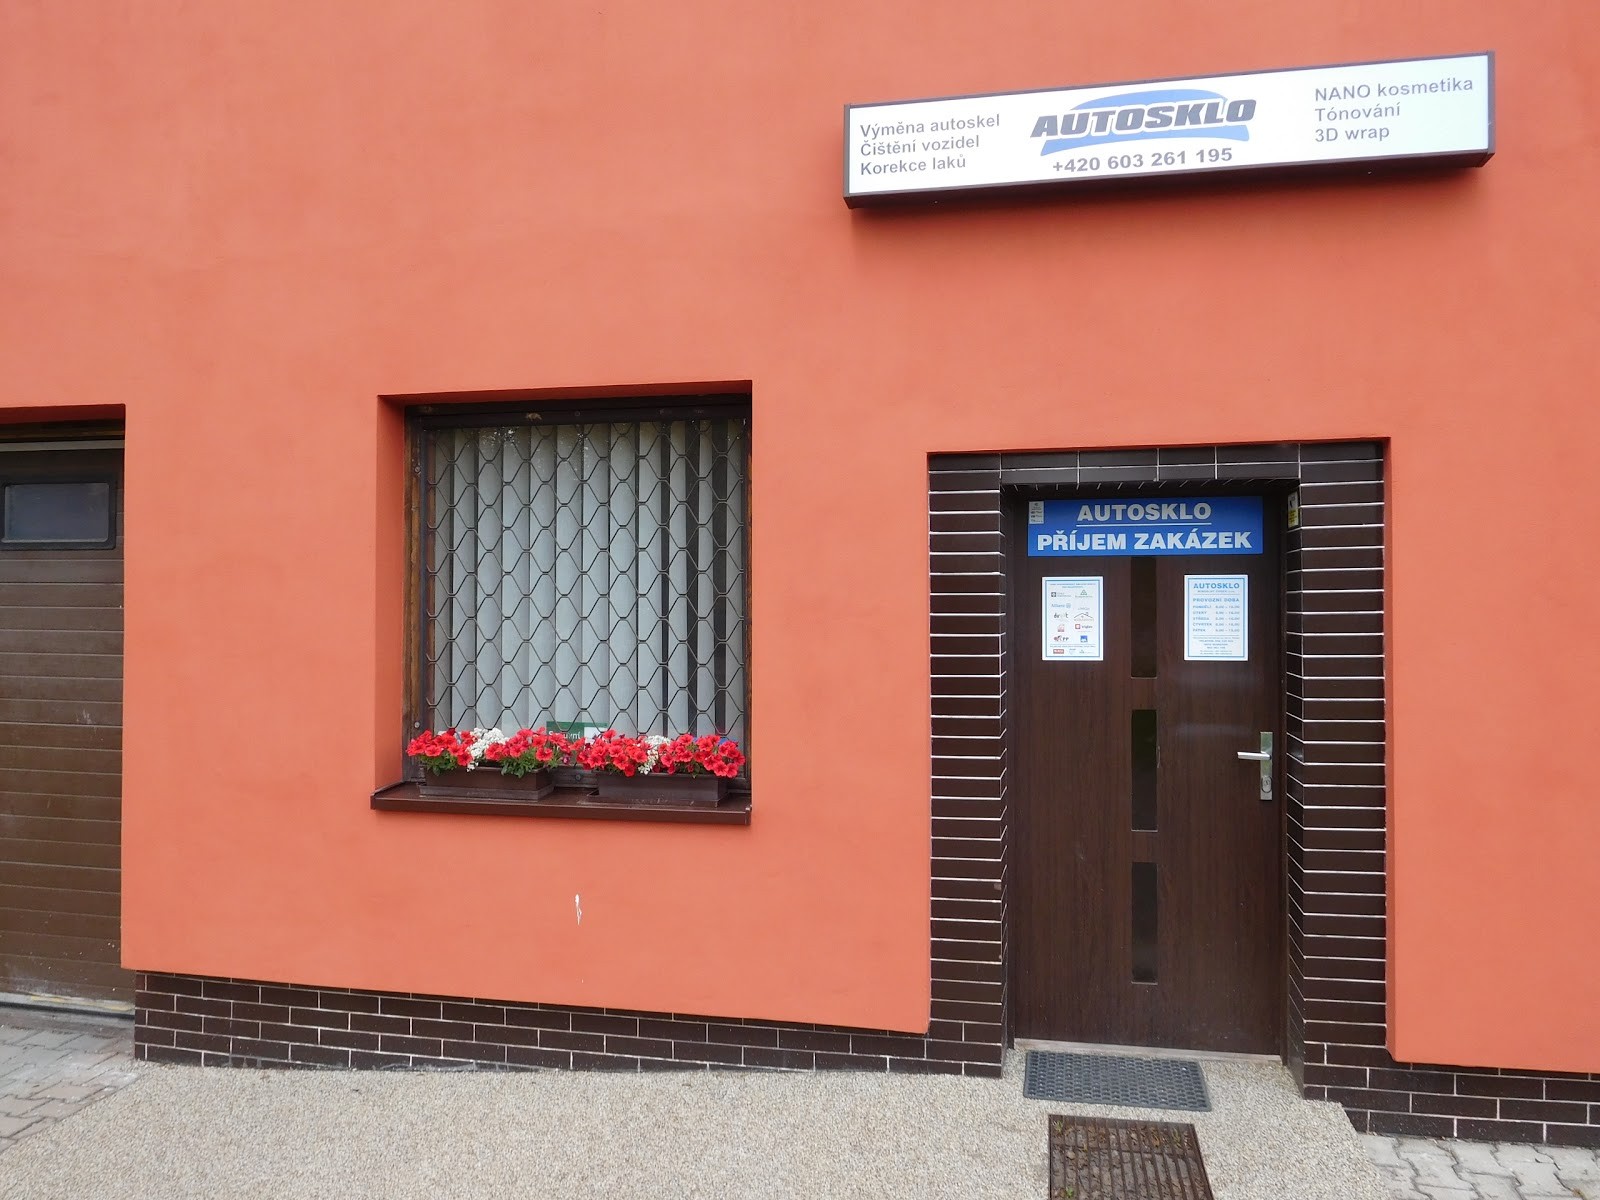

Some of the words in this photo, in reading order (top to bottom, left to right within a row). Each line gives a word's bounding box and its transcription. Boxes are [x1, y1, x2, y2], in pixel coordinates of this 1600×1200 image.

[1314, 84, 1371, 102] NANO
[1377, 77, 1474, 99] kosmetika
[1030, 98, 1257, 138] AUTOSKLO
[1314, 102, 1401, 122] Tónování
[860, 120, 925, 140] Výměna
[930, 113, 1001, 132] autoskel
[1314, 127, 1339, 143] 3D
[1344, 124, 1390, 142] wrap
[860, 138, 917, 157] Čištění
[921, 134, 980, 151] vozidel
[860, 159, 927, 176] Korekce
[932, 153, 967, 171] laků
[1053, 156, 1100, 173] +420
[1107, 153, 1144, 170] 603
[1150, 151, 1187, 167] 261
[1195, 147, 1233, 164] 195
[1077, 502, 1212, 522] AUTOSKLO
[1037, 529, 1127, 551] PŘÍJEM
[1134, 527, 1252, 550] ZAKÁZEK
